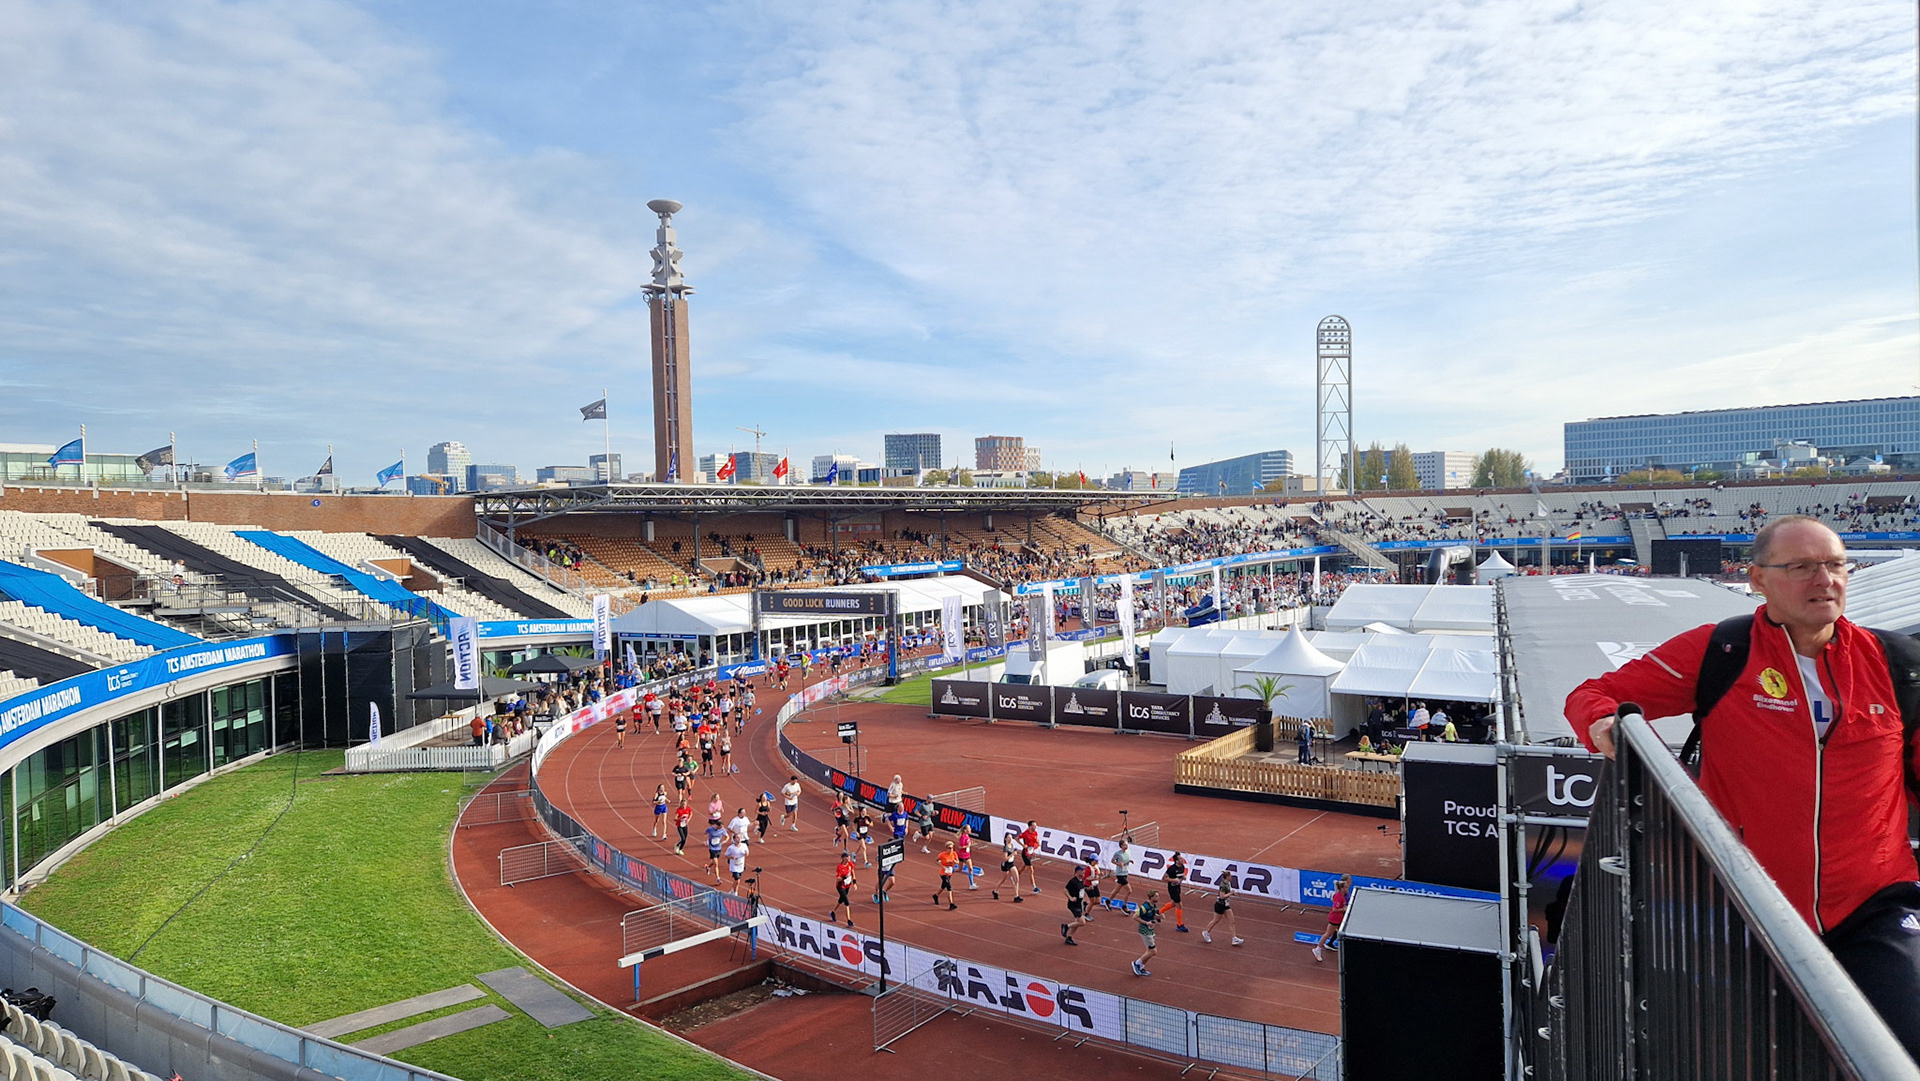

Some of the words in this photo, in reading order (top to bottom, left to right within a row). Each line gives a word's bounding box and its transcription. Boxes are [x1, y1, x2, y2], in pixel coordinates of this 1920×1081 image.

[783, 598, 804, 608] GOOD
[805, 598, 824, 608] LUCK
[825, 599, 860, 609] RUNNERS
[517, 624, 528, 634] TCS
[529, 623, 566, 634] AMSTERDAM
[166, 658, 180, 674] TCS
[179, 649, 225, 671] AMSTERDAM
[224, 643, 266, 663] MARATHON
[107, 674, 121, 691] tcs
[1, 699, 42, 734] AMSTERDAM
[41, 685, 82, 716] MARATHON
[999, 694, 1017, 709] tcs
[1130, 703, 1150, 719] tcs
[1547, 764, 1599, 808] tc
[1444, 800, 1497, 818] Proud
[1443, 820, 1480, 837] TCS
[1303, 887, 1336, 899] KLM
